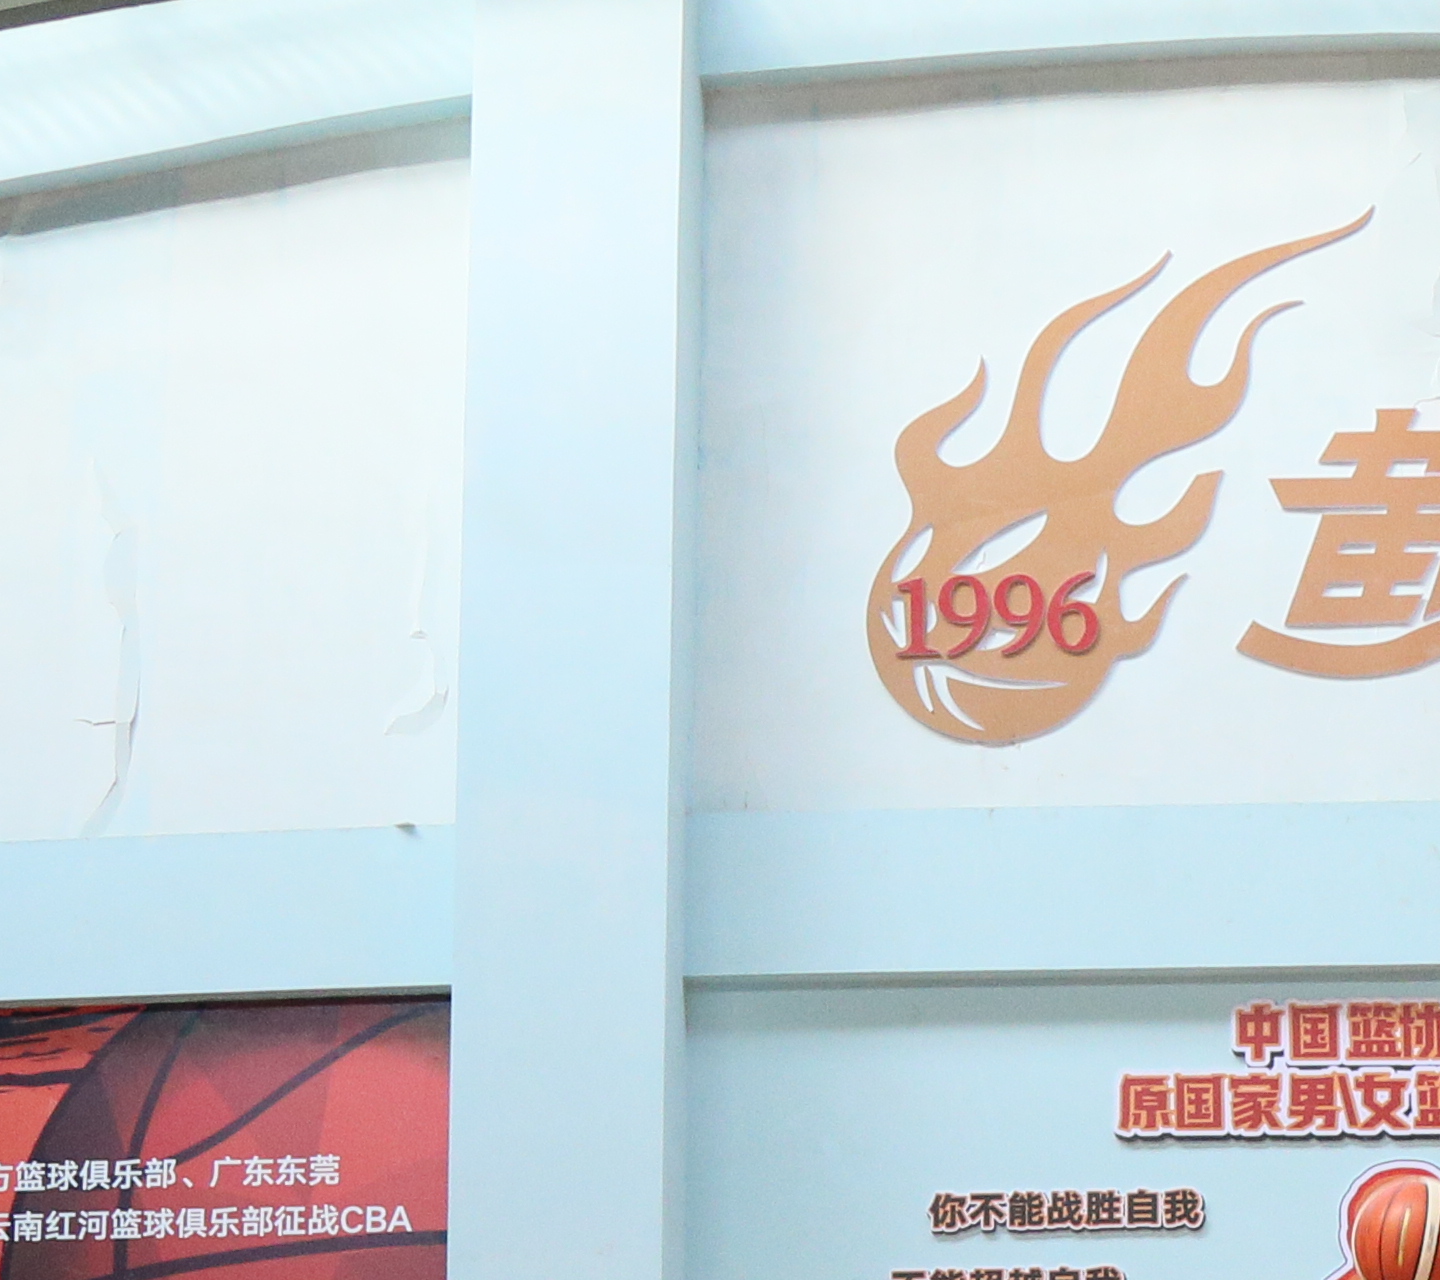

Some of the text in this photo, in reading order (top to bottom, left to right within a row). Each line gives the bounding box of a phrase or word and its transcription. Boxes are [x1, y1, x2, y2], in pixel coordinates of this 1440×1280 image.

[895, 570, 1101, 658] 1996
[929, 1189, 1204, 1232] 你不能战胜自我
